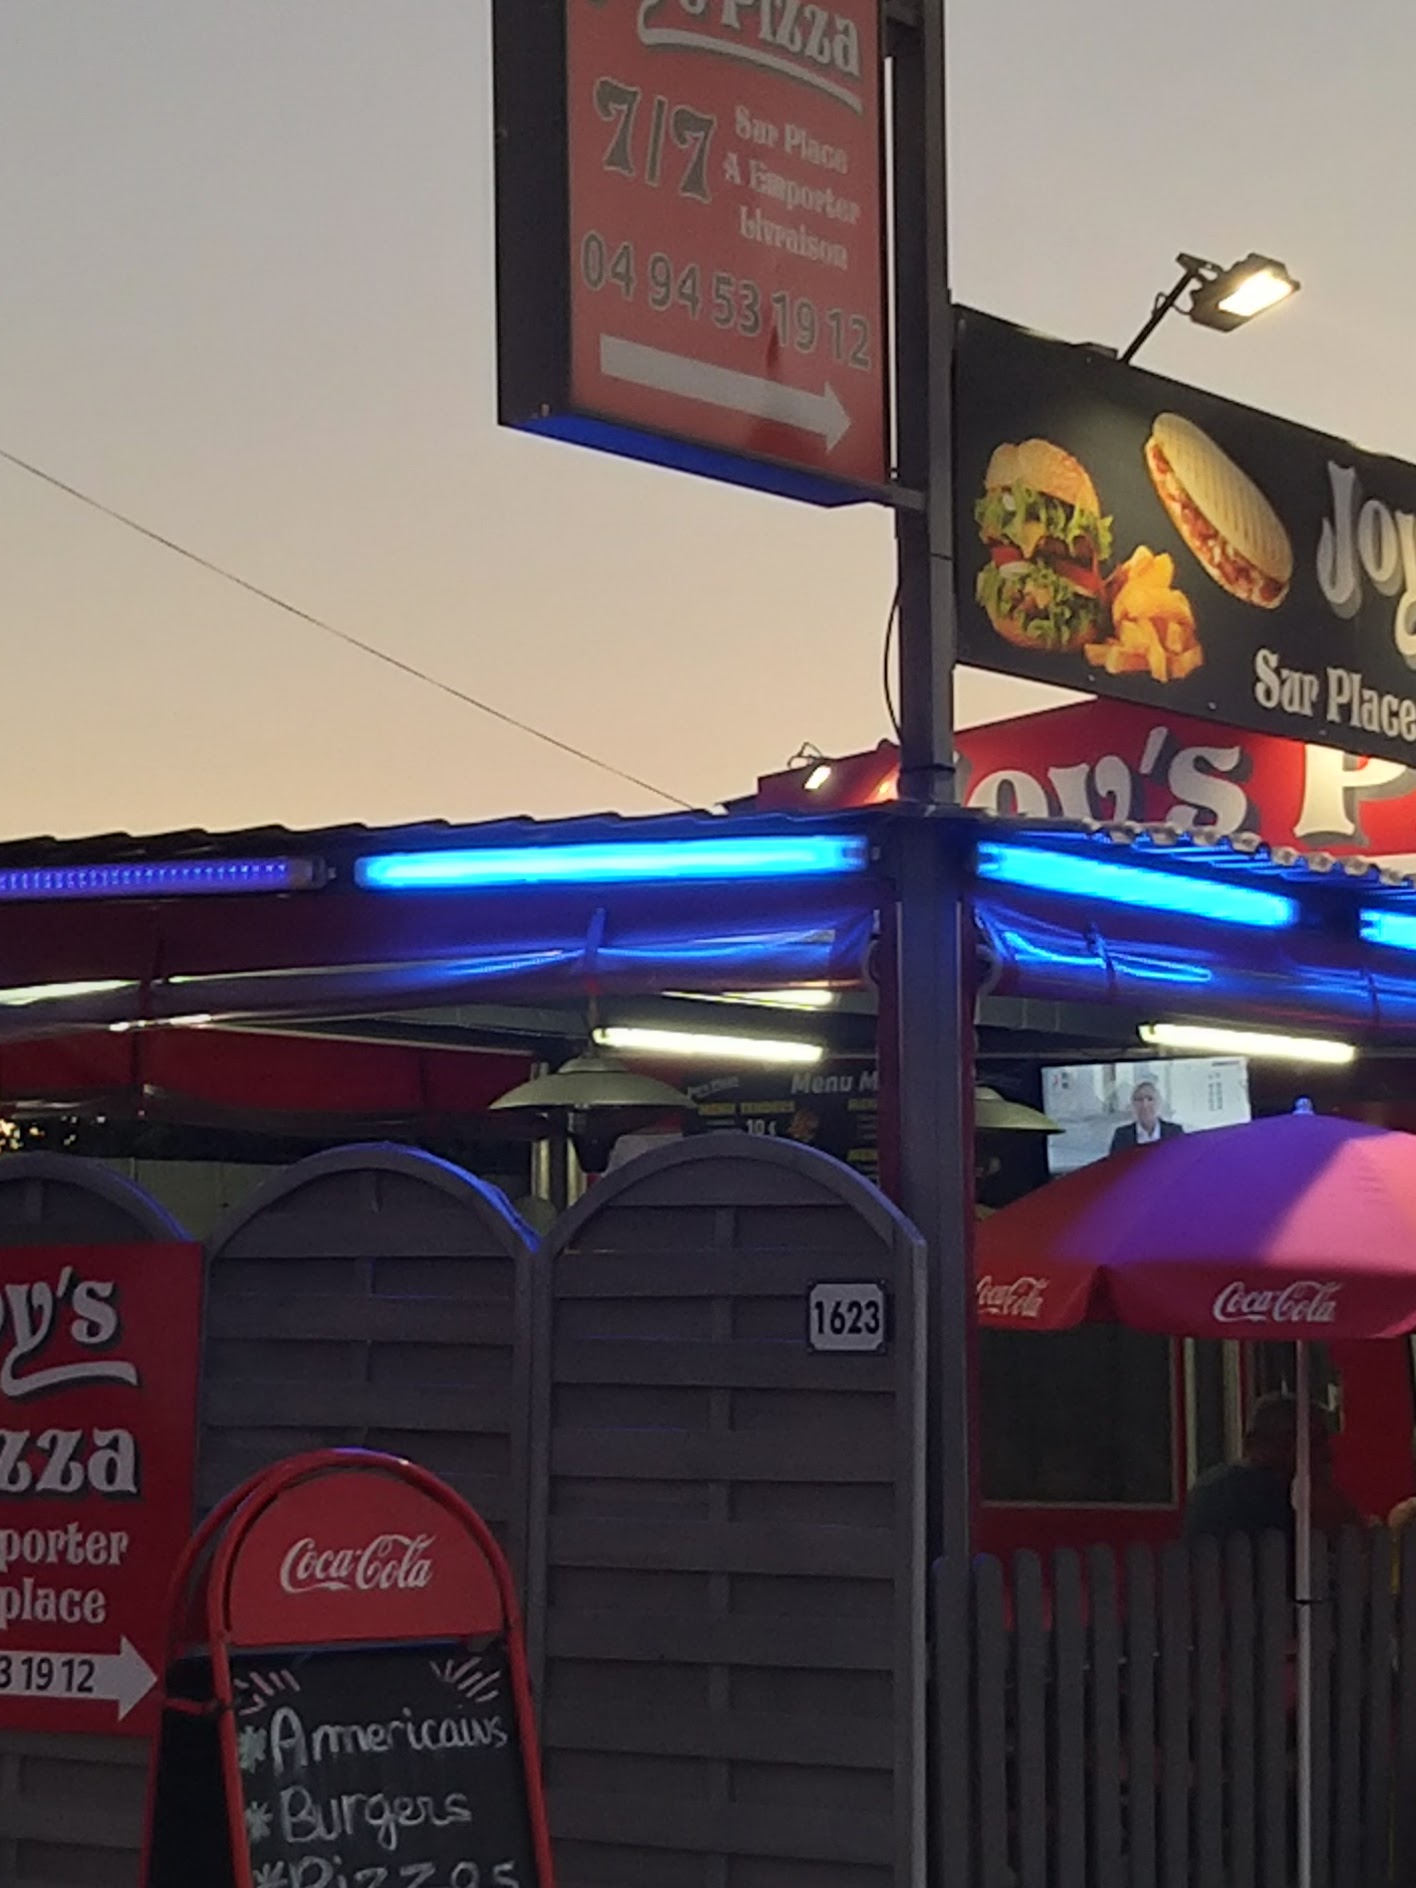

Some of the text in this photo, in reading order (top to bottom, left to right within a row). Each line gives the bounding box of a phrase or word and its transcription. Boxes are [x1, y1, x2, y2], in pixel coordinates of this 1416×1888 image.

[594, 78, 715, 204] 7/7
[785, 124, 848, 174] Place
[724, 152, 860, 224] A Emporter
[739, 205, 848, 270] Livraison
[582, 229, 872, 371] 04 94 53 19 12
[1255, 646, 1318, 714] Sur
[1326, 667, 1416, 742] Place
[791, 1071, 853, 1095] Menu
[813, 1299, 882, 1337] 1623
[279, 1533, 437, 1594] Coca-Cola
[20, 1656, 57, 1692] 19
[60, 1658, 96, 1694] 12
[280, 1784, 473, 1852] Burgers
